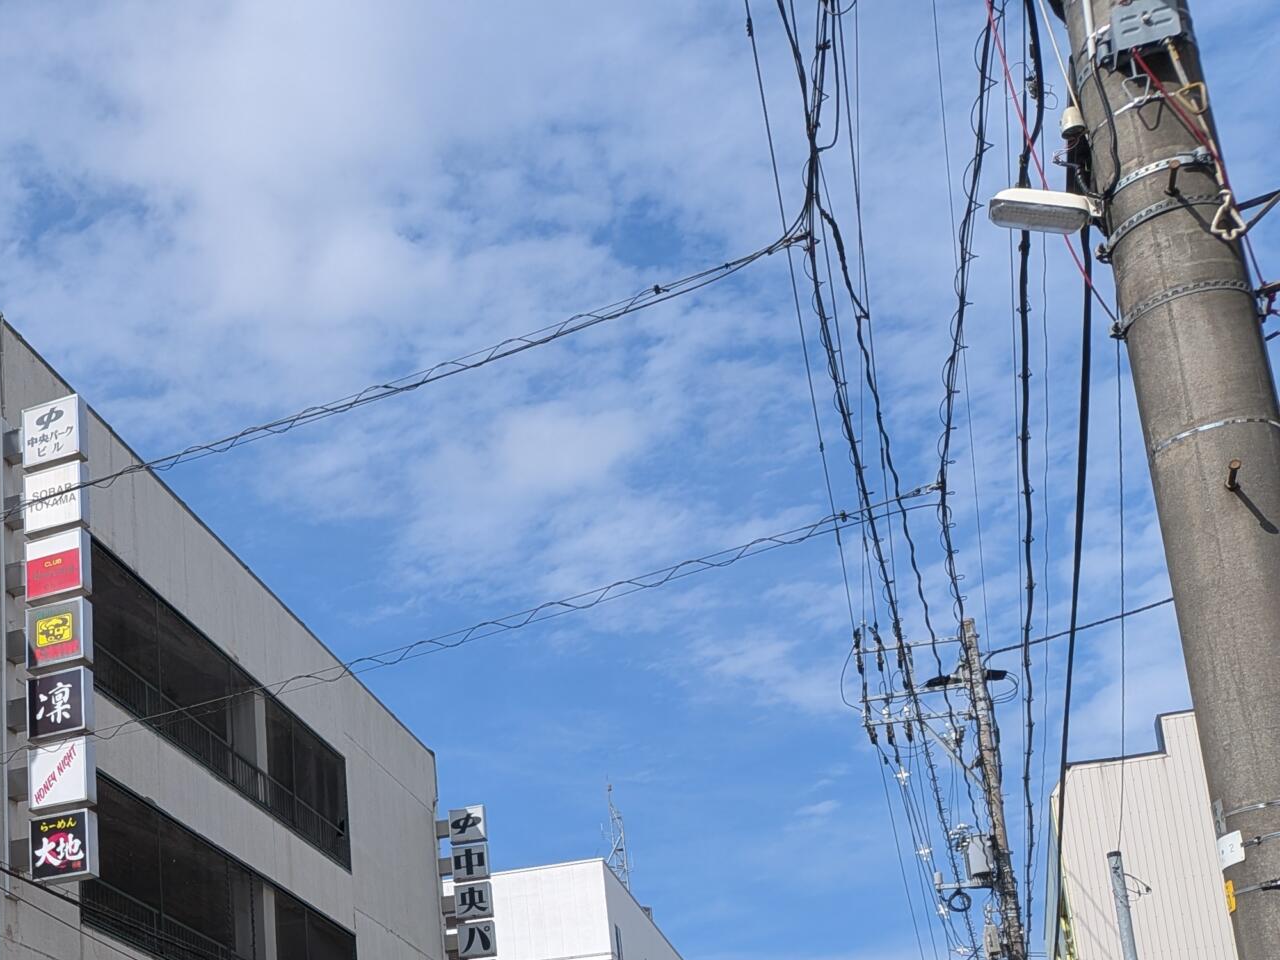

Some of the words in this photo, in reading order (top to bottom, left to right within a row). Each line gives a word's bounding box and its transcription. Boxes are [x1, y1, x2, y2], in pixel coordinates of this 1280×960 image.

[27, 425, 73, 447] 中央パーク
[37, 441, 65, 457] ビル
[32, 482, 73, 501] SOBAR
[28, 492, 76, 513] TOYAMA
[34, 772, 58, 805] HONEY
[56, 743, 78, 777] NIGHT
[40, 816, 77, 833] らーめん
[34, 833, 85, 868] 大地
